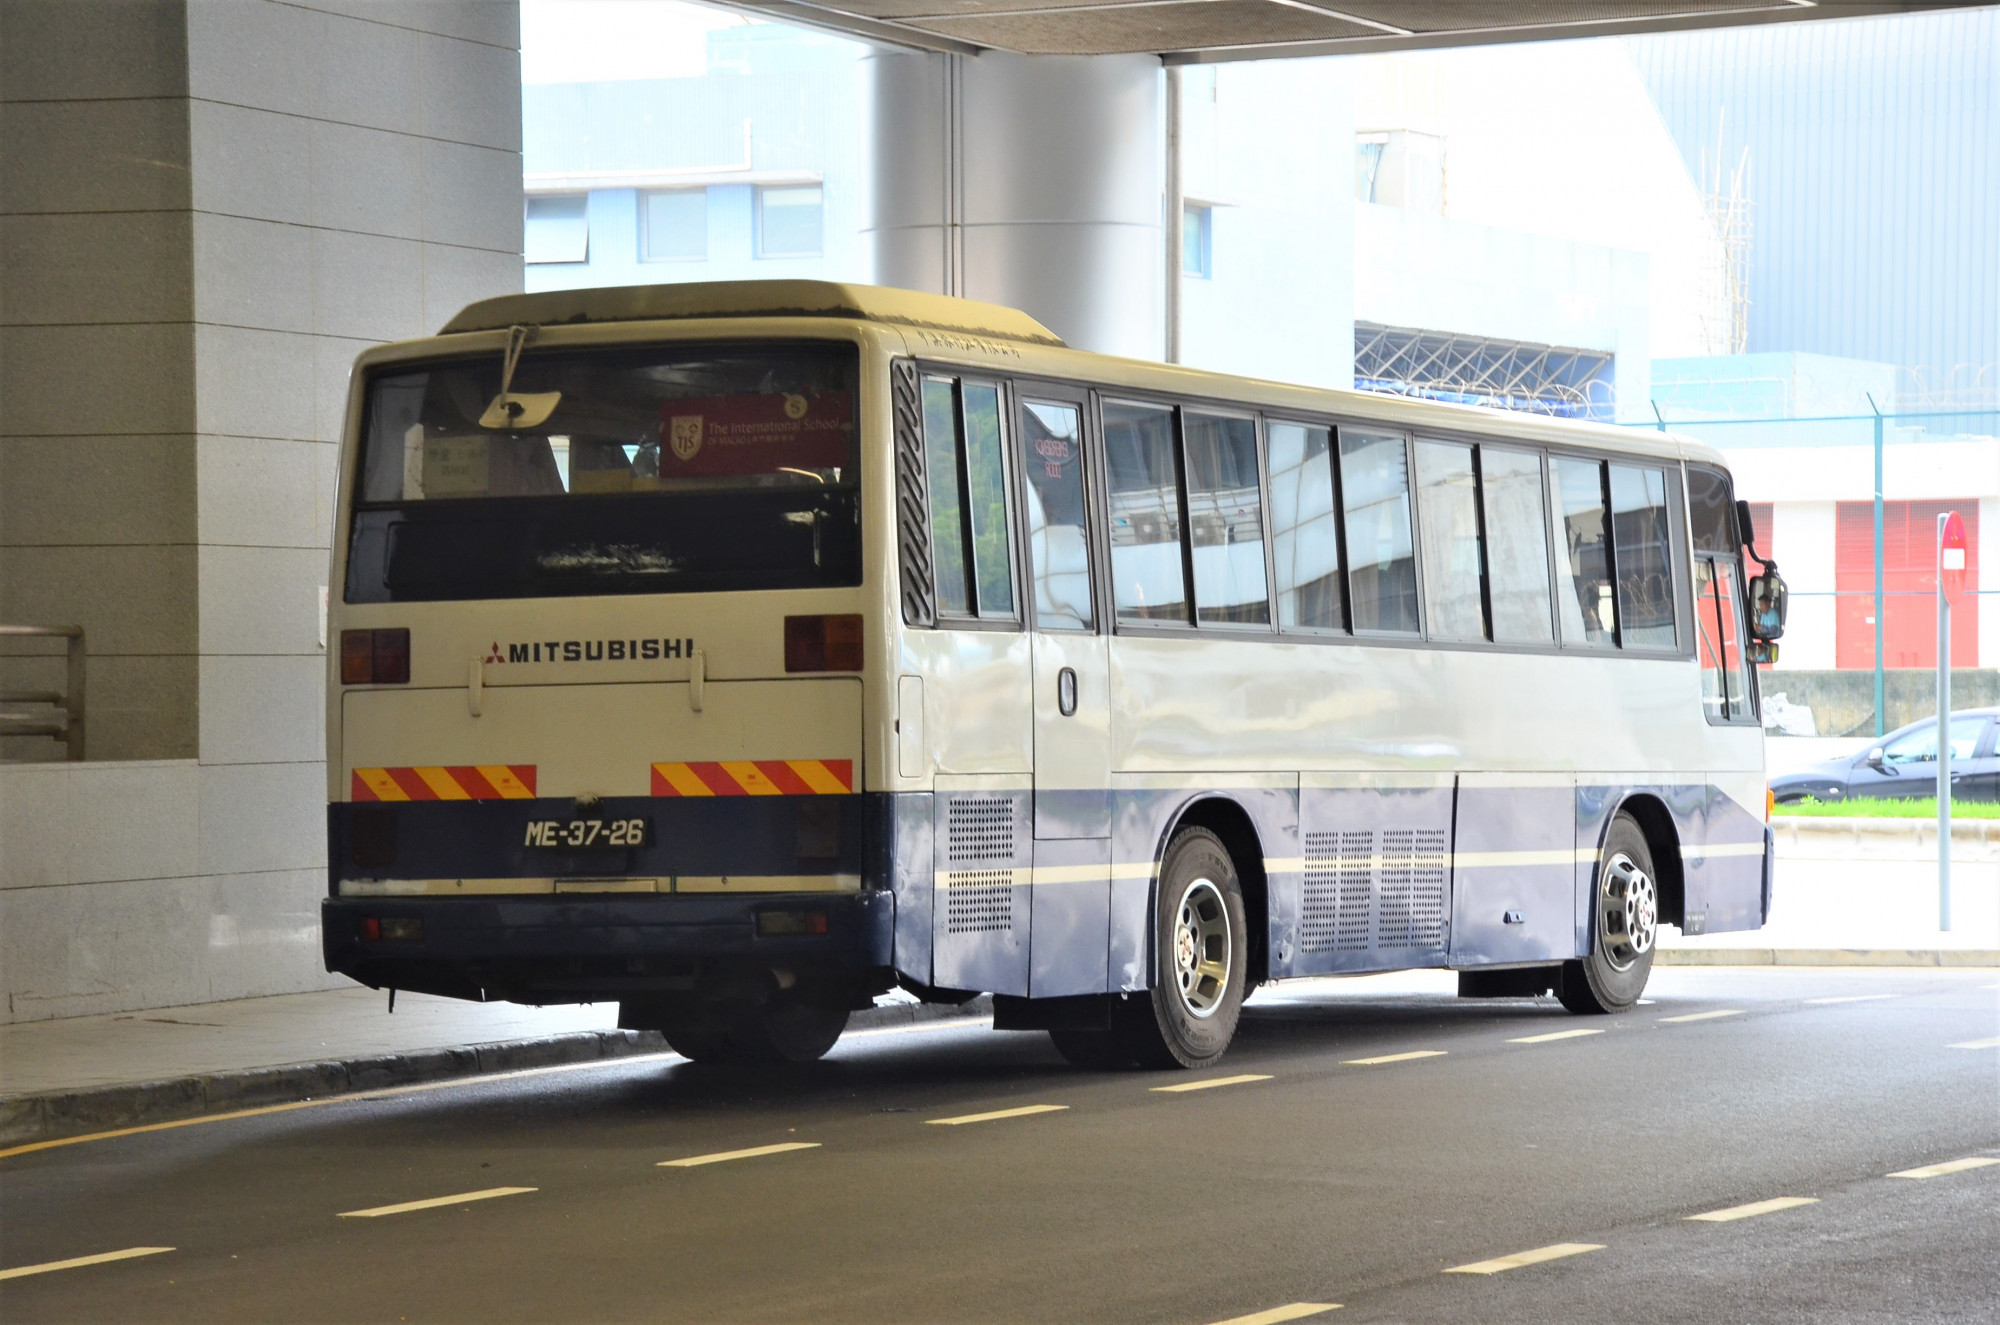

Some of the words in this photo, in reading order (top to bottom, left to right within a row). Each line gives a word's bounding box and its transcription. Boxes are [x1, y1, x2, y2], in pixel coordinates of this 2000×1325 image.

[708, 421, 728, 435] The
[730, 419, 801, 434] International
[803, 416, 840, 431] School
[509, 638, 694, 663] MITSUBISHI
[524, 819, 645, 847] ME-37-26
